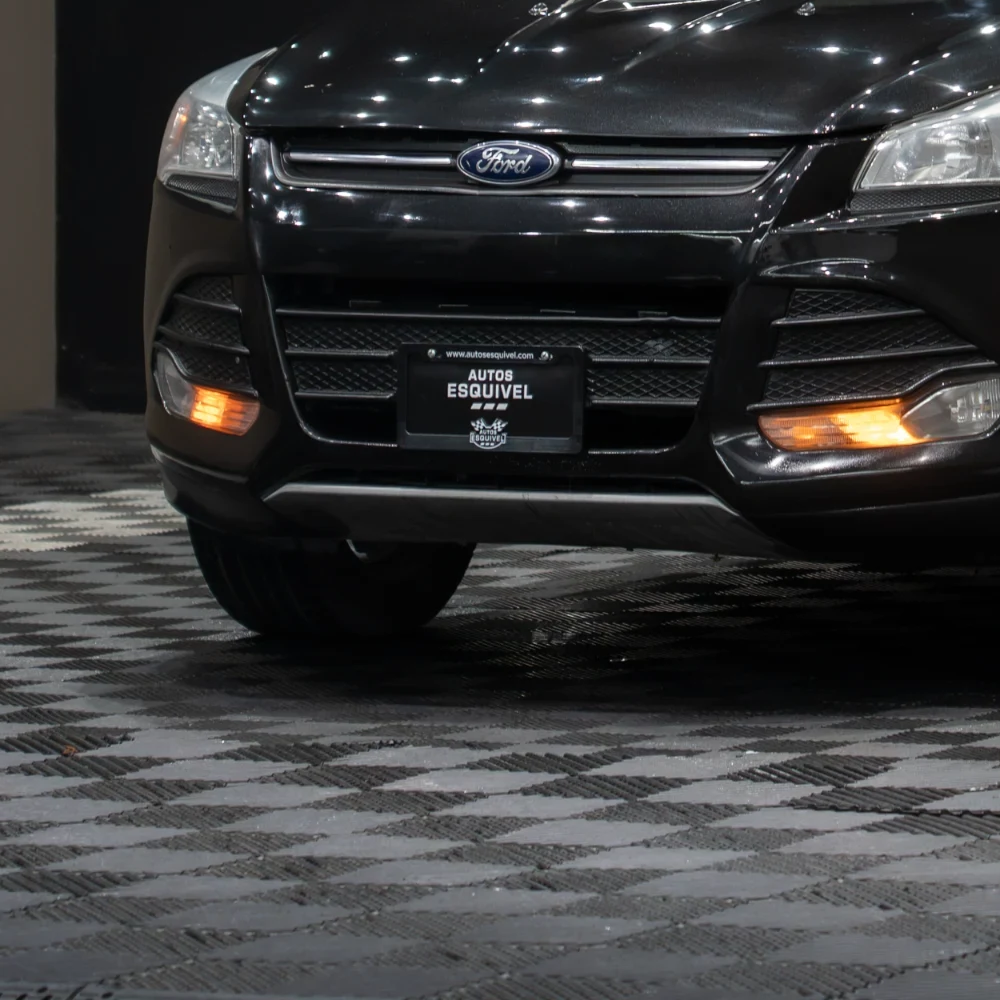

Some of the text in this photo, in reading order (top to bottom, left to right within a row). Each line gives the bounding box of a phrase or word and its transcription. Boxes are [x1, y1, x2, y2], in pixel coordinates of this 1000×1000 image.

[476, 147, 533, 174] Ford
[446, 351, 534, 360] www.autosesquivel.com
[468, 369, 513, 382] AUTOS
[447, 383, 533, 399] ESQUIVEL
